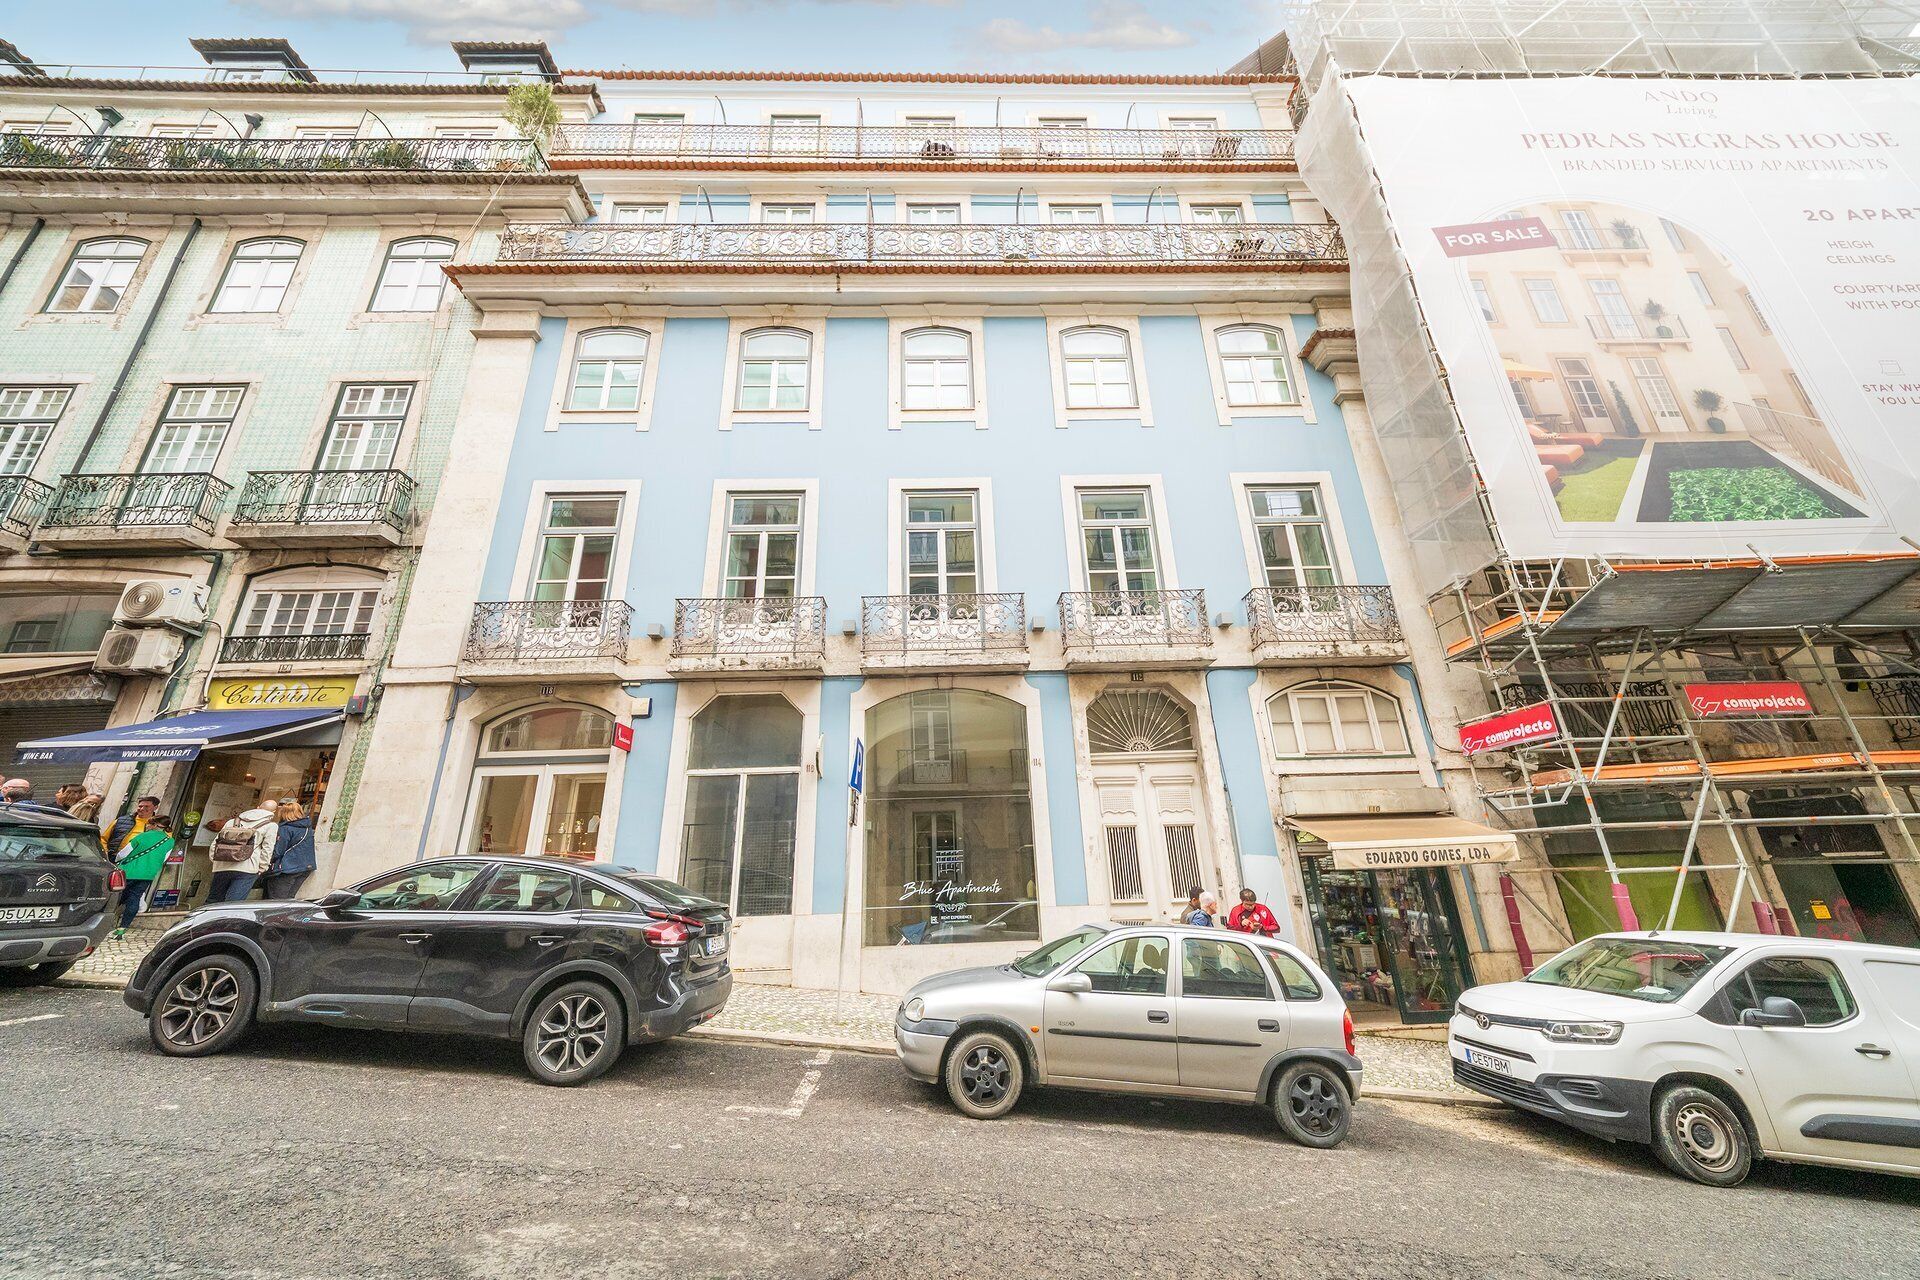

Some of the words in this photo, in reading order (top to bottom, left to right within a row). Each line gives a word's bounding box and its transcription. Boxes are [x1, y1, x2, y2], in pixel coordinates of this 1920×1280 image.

[1644, 90, 1718, 103] ANDO
[1666, 104, 1718, 119] Living
[1520, 132, 1646, 149] PEDRAS
[1651, 132, 1781, 149] NEGRAS
[1785, 132, 1900, 149] HOUSE
[1562, 159, 1656, 172] BRANDED
[1661, 158, 1754, 171] SERVICED
[1760, 158, 1889, 171] APARTMENTS
[1802, 209, 1835, 221] 20
[1444, 232, 1488, 248] FOR
[1491, 226, 1543, 243] SALE
[1826, 240, 1875, 249] HEIGH
[1826, 254, 1896, 264] CEILINGS
[1846, 300, 1889, 310] WITH
[1862, 383, 1894, 393] STAY
[1877, 396, 1907, 405] YOU
[222, 682, 345, 705] Centivinte
[1722, 695, 1806, 710] comprojecto
[1485, 719, 1553, 745] comprojecto
[40, 752, 54, 760] BAR
[854, 743, 863, 785] P
[1366, 851, 1419, 865] EDUARDO
[1422, 848, 1466, 863] GOMES,
[1469, 847, 1491, 860] LDA
[899, 881, 935, 901] Blue
[936, 878, 1003, 902] Apartments
